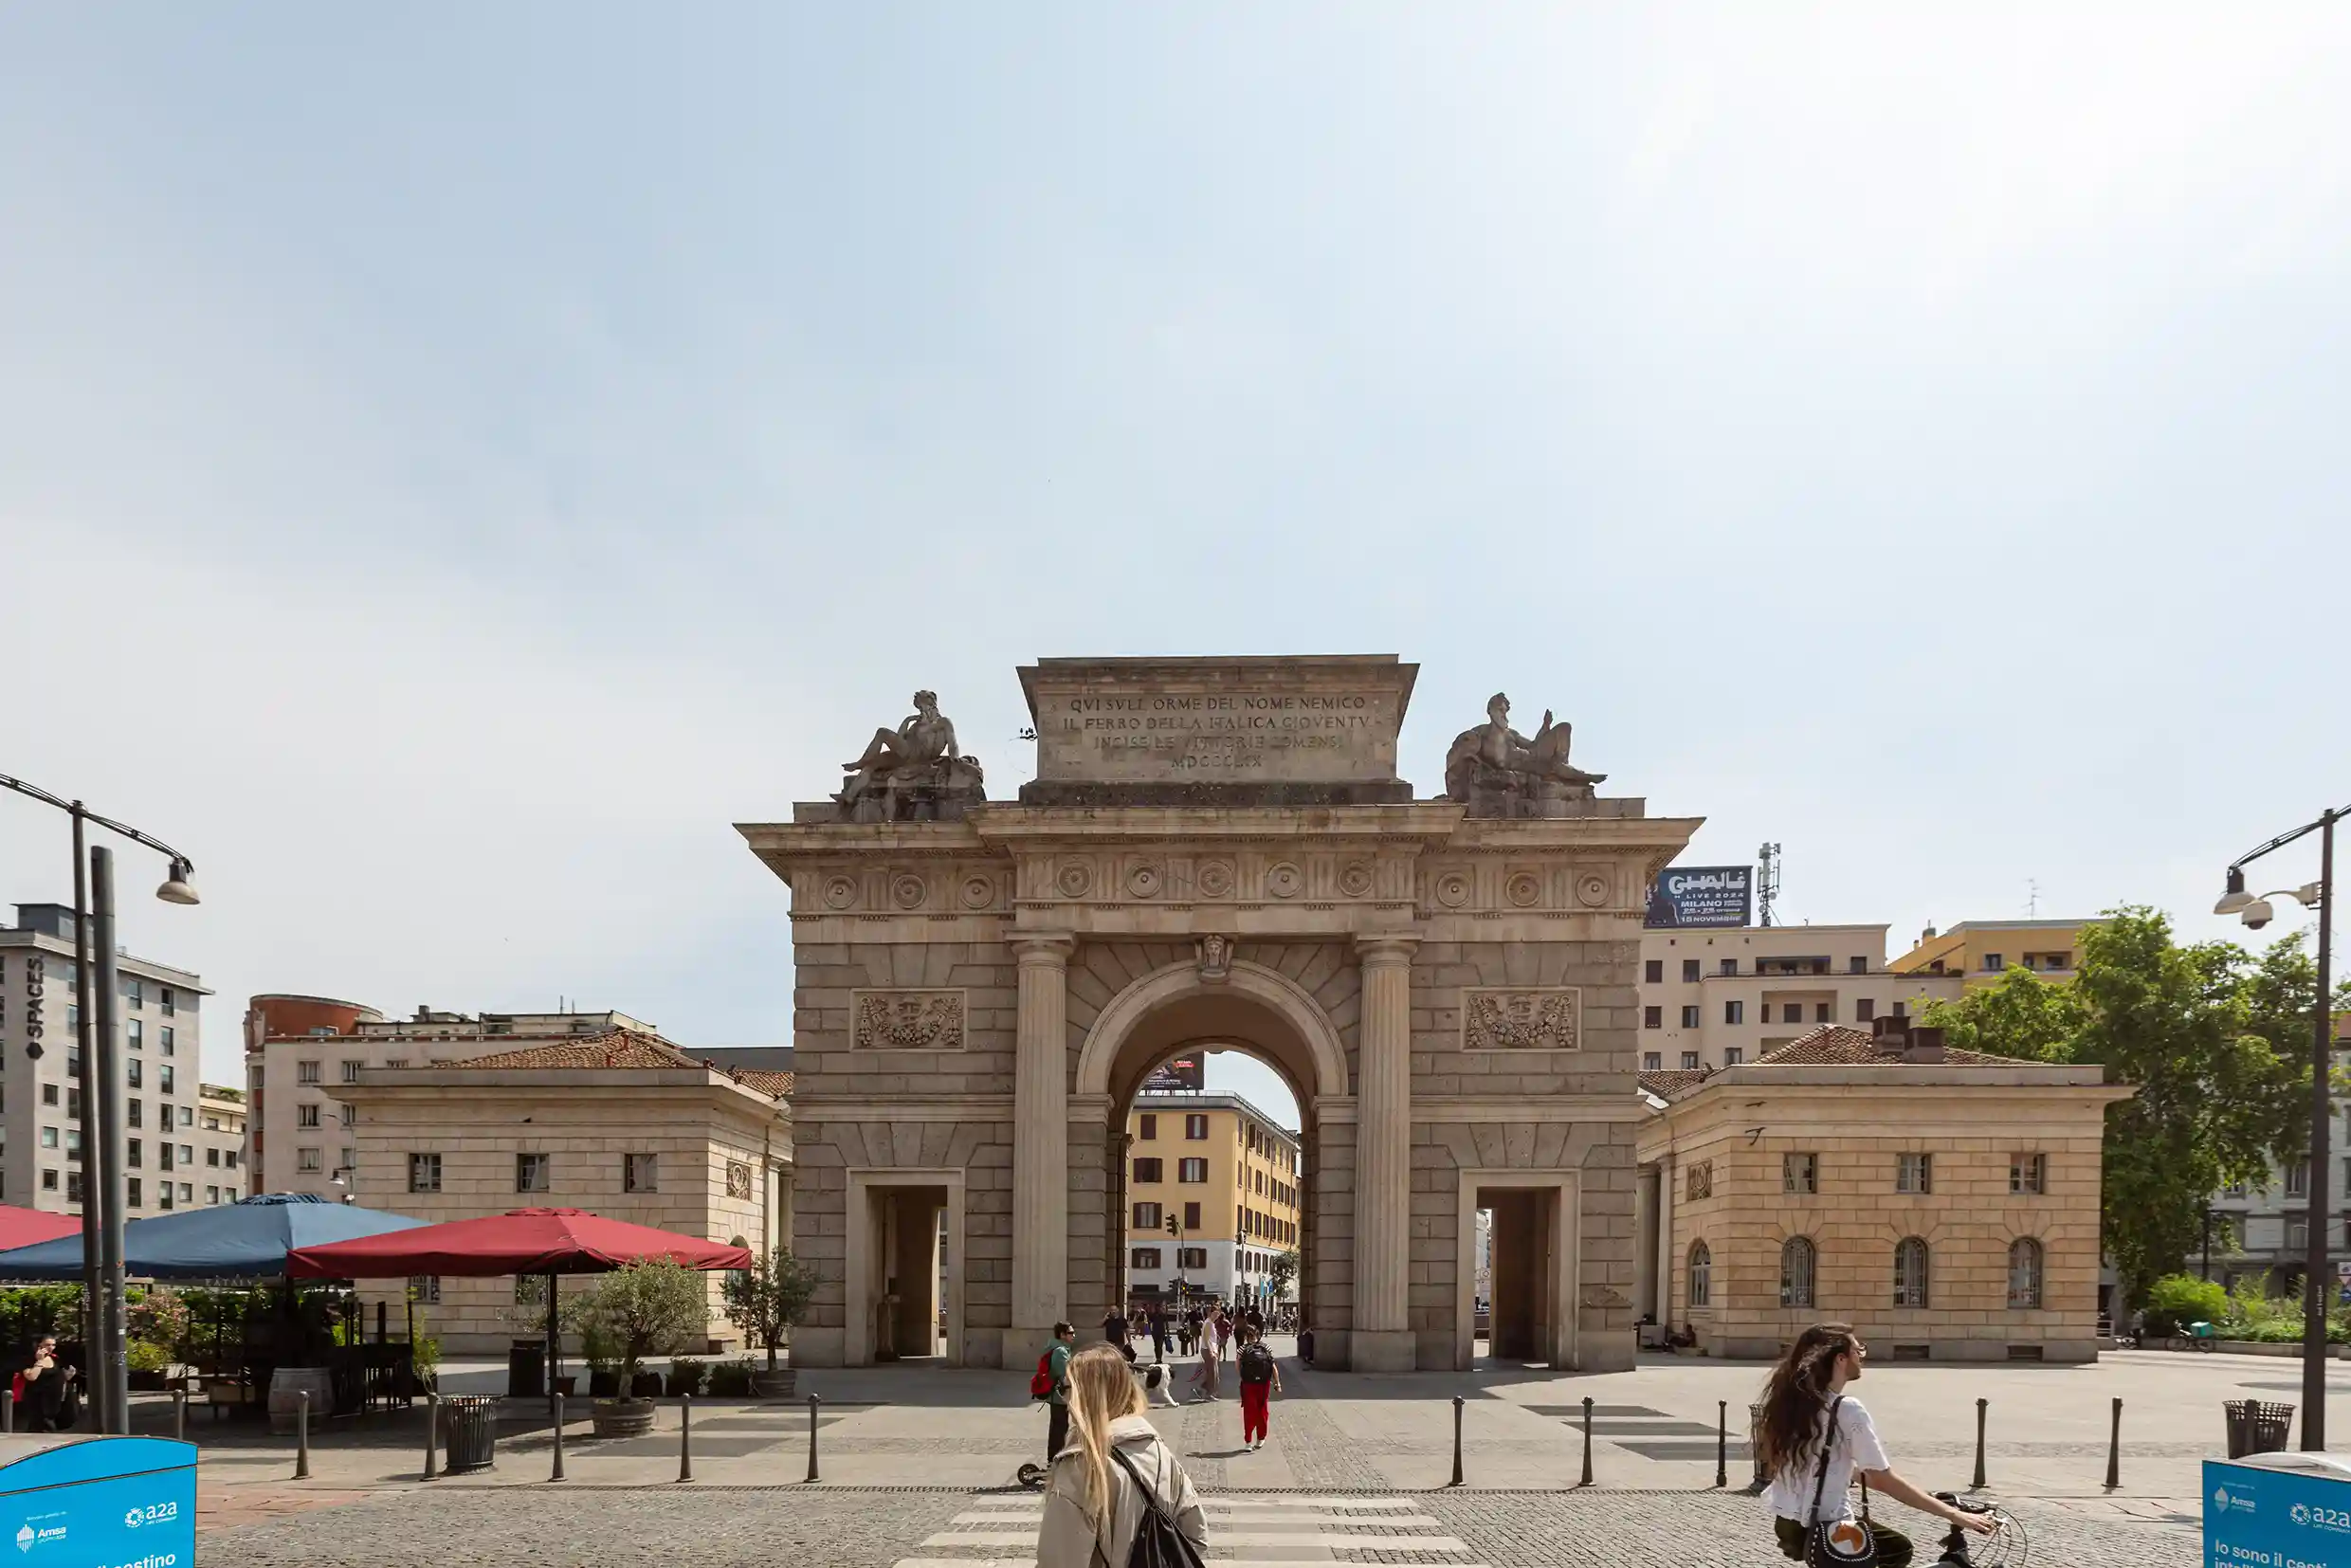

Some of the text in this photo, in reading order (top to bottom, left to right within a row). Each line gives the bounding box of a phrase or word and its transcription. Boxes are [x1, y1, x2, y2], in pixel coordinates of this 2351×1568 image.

[1070, 698, 1101, 713] QVI
[1153, 699, 1202, 710] ORME
[1207, 698, 1238, 710] DEL
[1244, 697, 1294, 710] NOME
[1299, 697, 1365, 710] NEMICO
[1064, 716, 1370, 730] IL FERRO DELLA ITALICA GIOVENTV
[145, 1502, 178, 1521] a2a
[2313, 1506, 2351, 1528] a2a
[38, 1526, 66, 1538] Amsa
[114, 1554, 176, 1568] stino
[2233, 1546, 2270, 1564] sono
[2273, 1552, 2283, 1568] il
